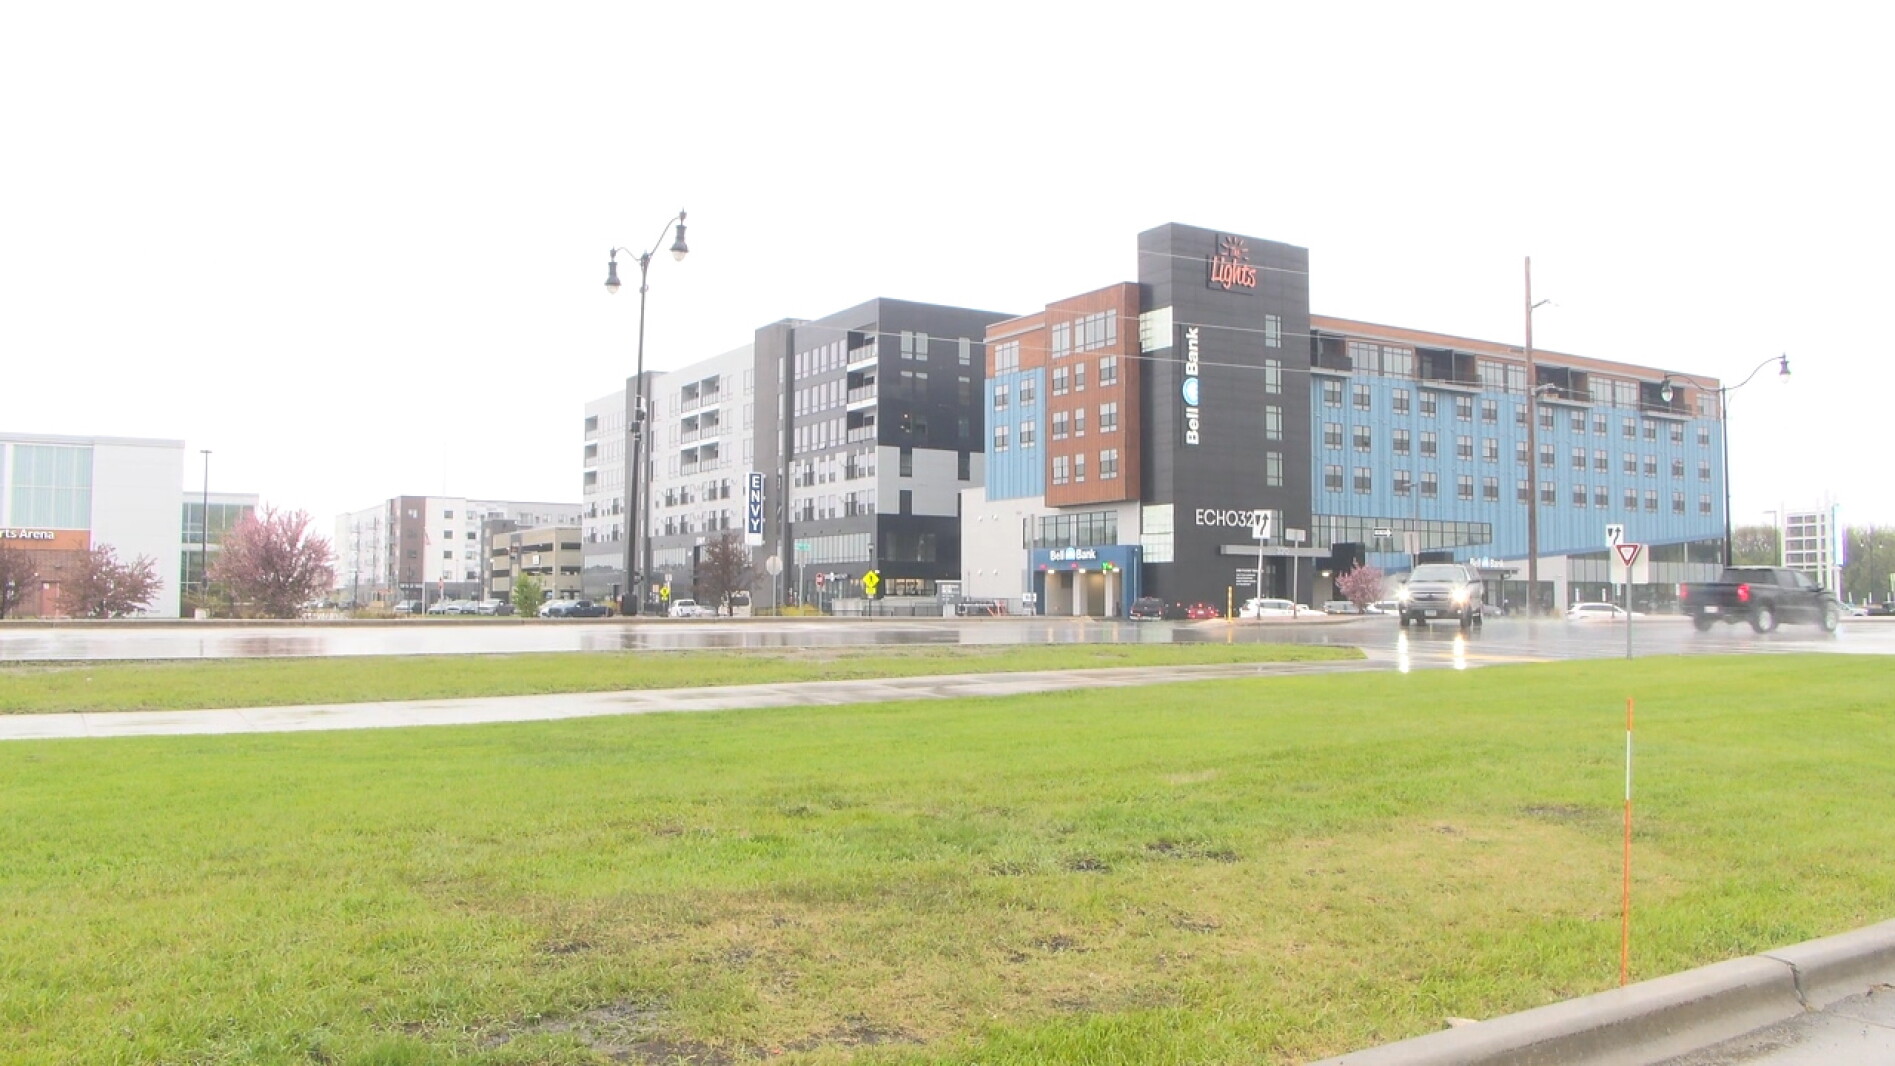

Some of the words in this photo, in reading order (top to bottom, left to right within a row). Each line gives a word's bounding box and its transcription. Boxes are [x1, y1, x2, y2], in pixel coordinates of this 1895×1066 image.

[1211, 256, 1256, 289] Lights
[1185, 327, 1199, 375] Bank
[1185, 407, 1199, 445] Bell
[751, 476, 761, 531] ENVY
[19, 529, 55, 540] Arena
[1050, 550, 1064, 561] Bell
[1076, 548, 1096, 559] Bank
